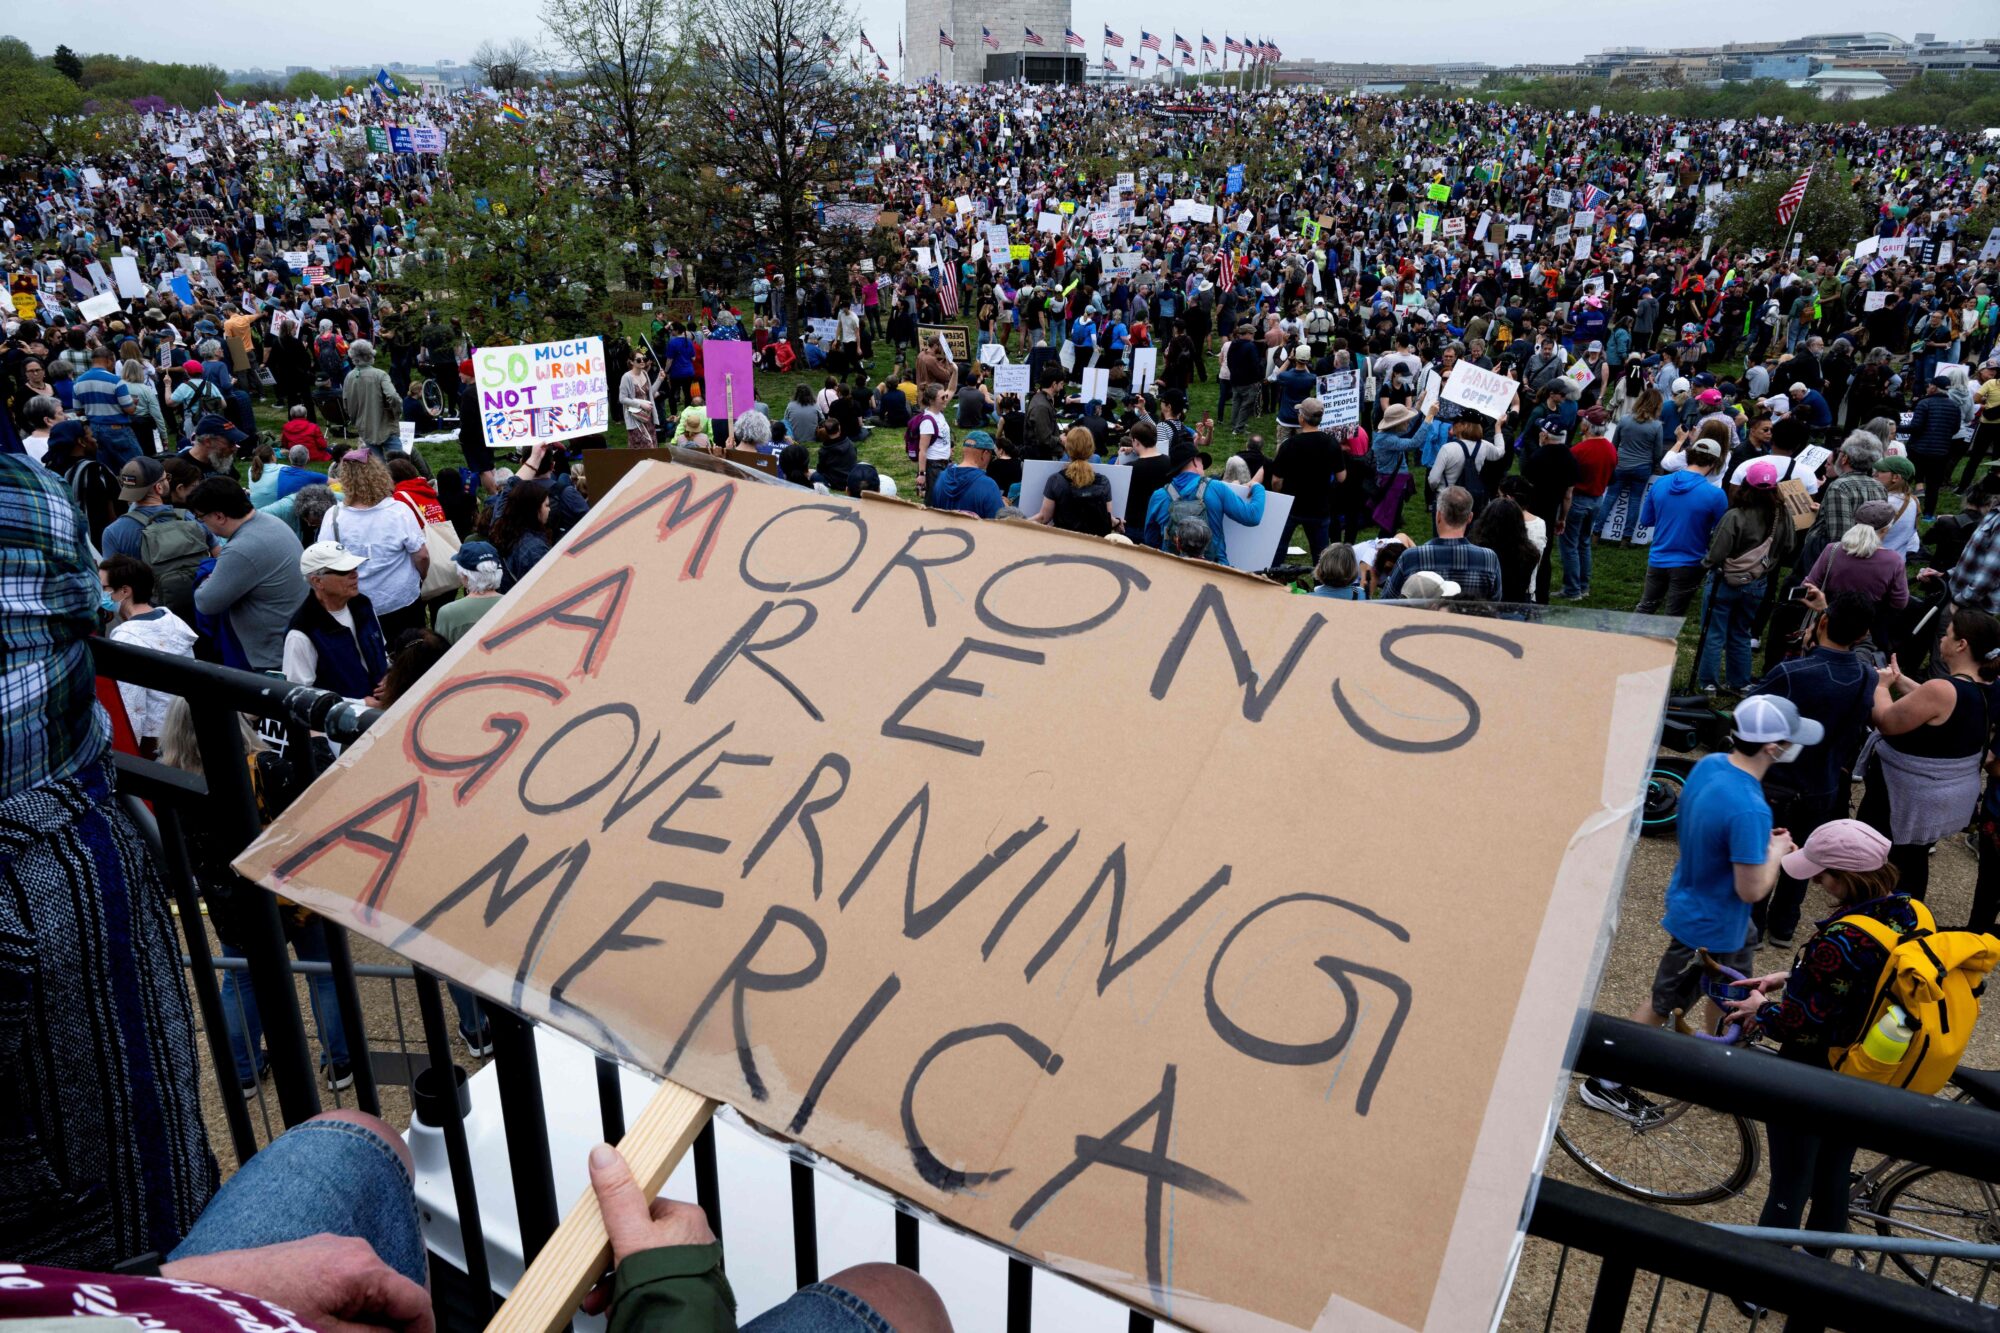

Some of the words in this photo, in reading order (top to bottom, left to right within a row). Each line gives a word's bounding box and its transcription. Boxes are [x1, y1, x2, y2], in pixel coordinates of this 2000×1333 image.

[1882, 244, 1905, 252] GRIFT
[481, 352, 529, 388] SO
[534, 341, 588, 361] MUCH
[535, 357, 606, 381] WRONG
[1461, 367, 1514, 397] HANDS
[484, 385, 537, 411] NOT
[551, 377, 609, 401] ENOUGH
[1333, 396, 1358, 407] PEOPLE
[1461, 387, 1494, 409] OFF!
[484, 406, 564, 443] POSTER
[563, 397, 609, 431] SPACE
[563, 472, 1524, 754] MORONS
[480, 565, 1046, 756] ARE
[402, 671, 1413, 1116] GOVERNING
[273, 776, 1249, 1306] AMERICA
